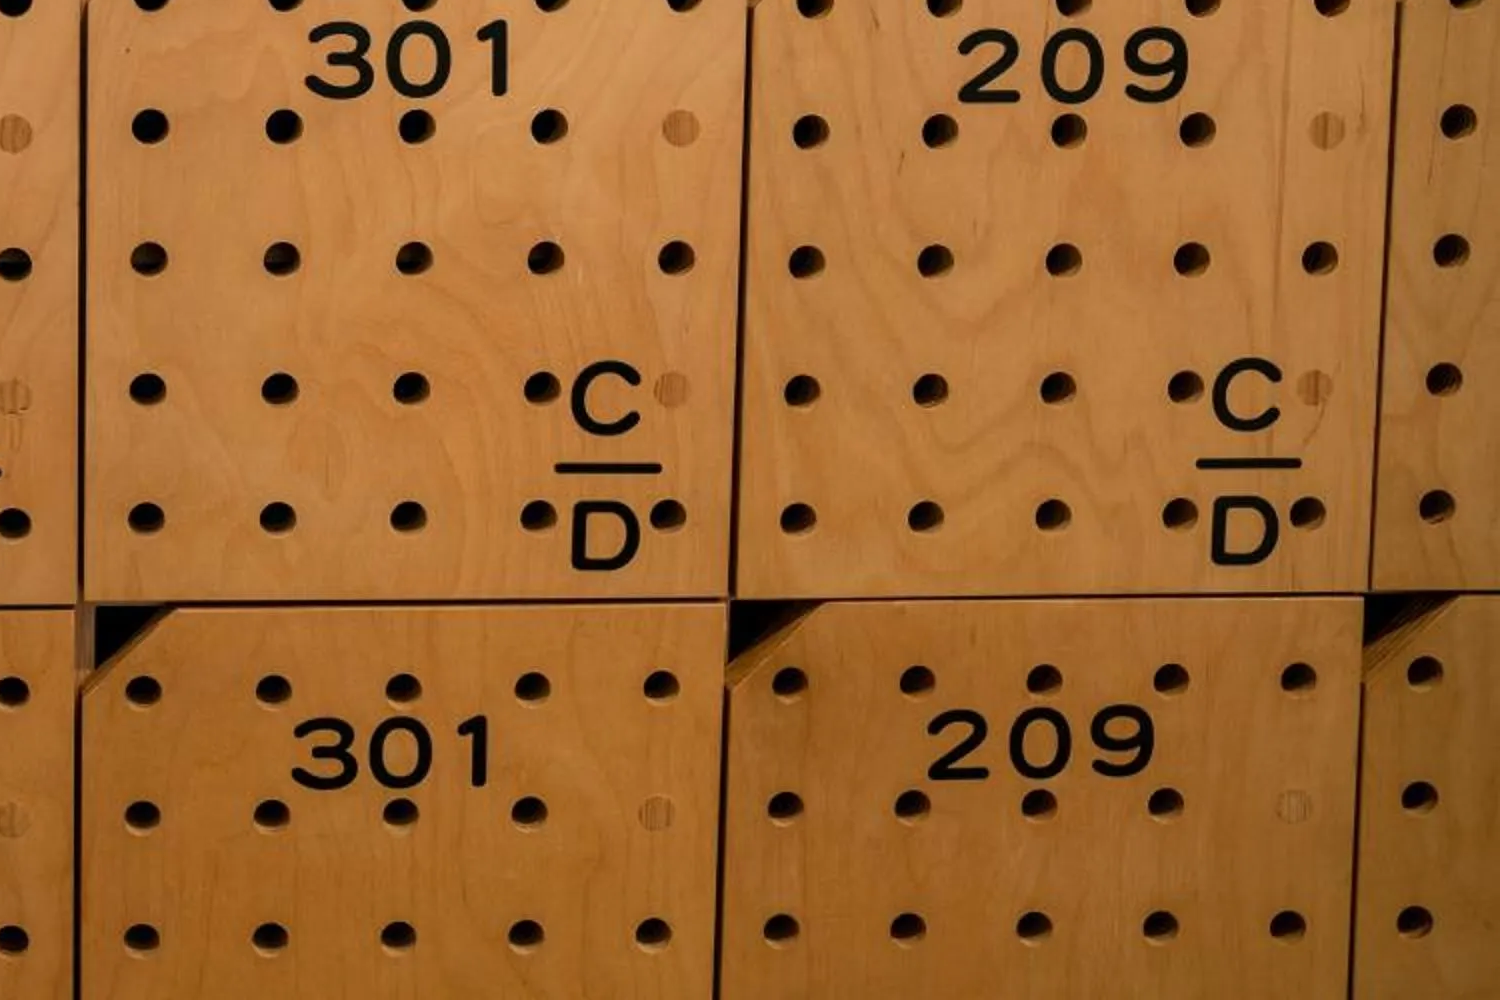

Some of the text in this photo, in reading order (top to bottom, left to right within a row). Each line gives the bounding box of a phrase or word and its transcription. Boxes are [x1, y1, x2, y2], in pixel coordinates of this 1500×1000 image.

[303, 18, 509, 101] 301
[956, 25, 1190, 106] 209
[569, 359, 643, 438] C
[1210, 356, 1284, 434] C
[569, 499, 642, 573] D
[1209, 494, 1281, 568] D
[289, 713, 489, 792] 301
[925, 702, 1156, 782] 209
